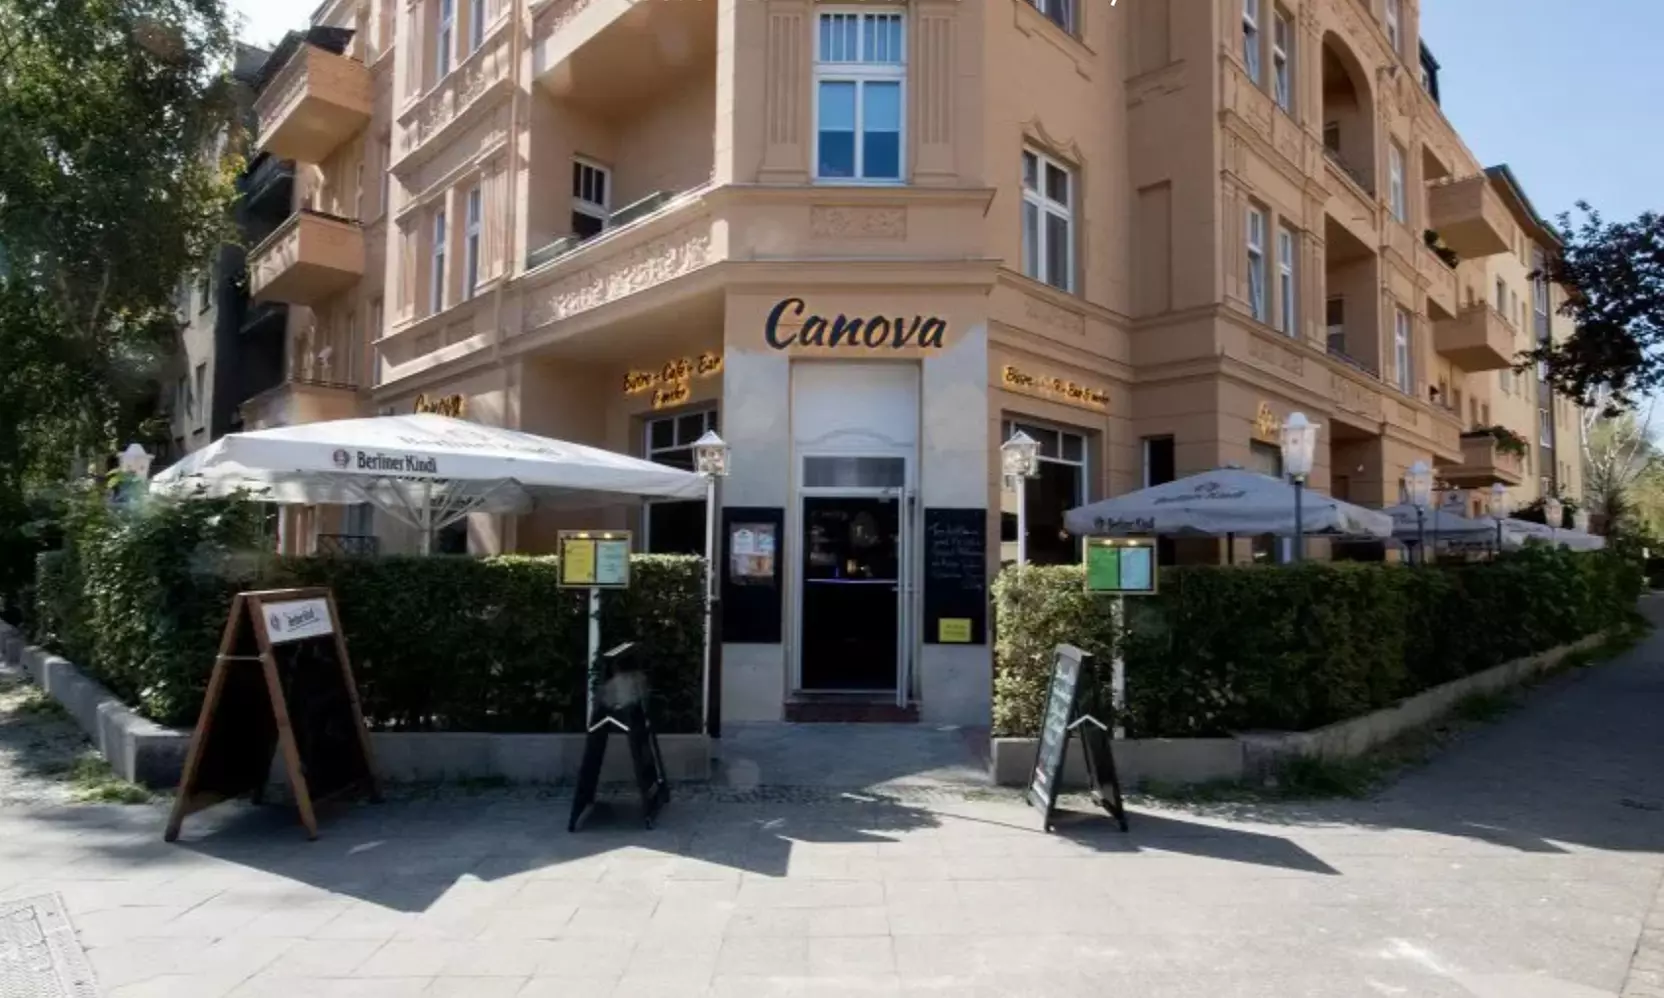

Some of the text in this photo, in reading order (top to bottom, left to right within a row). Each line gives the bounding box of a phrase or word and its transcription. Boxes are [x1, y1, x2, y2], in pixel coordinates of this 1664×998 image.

[765, 297, 947, 350] Canova
[357, 451, 404, 471] Berliner
[406, 454, 437, 474] Kindl
